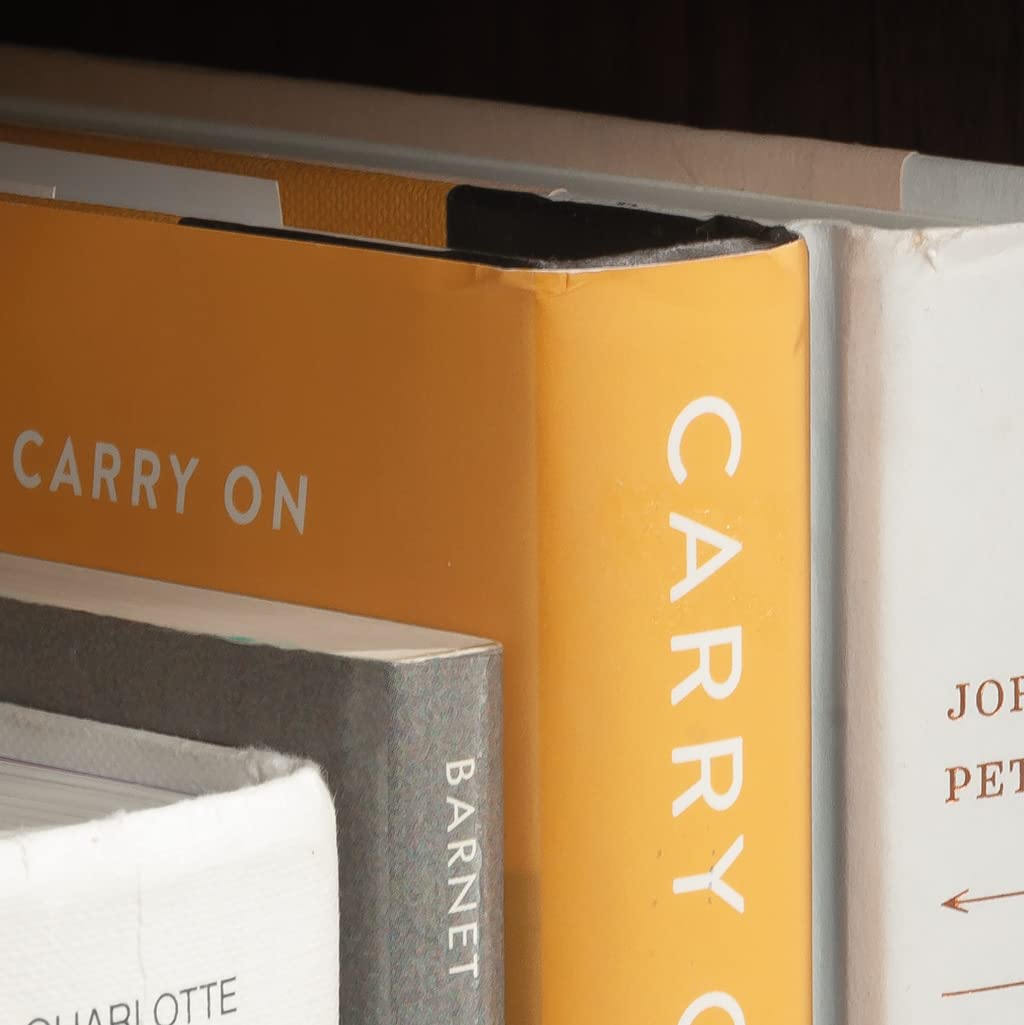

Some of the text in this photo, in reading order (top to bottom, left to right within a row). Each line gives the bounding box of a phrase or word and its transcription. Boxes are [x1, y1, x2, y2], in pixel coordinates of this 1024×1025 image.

[12, 429, 308, 535] CARRY ON
[666, 395, 745, 914] CARRY
[445, 758, 479, 978] BARNET
[26, 976, 238, 1025] RLOTTE
